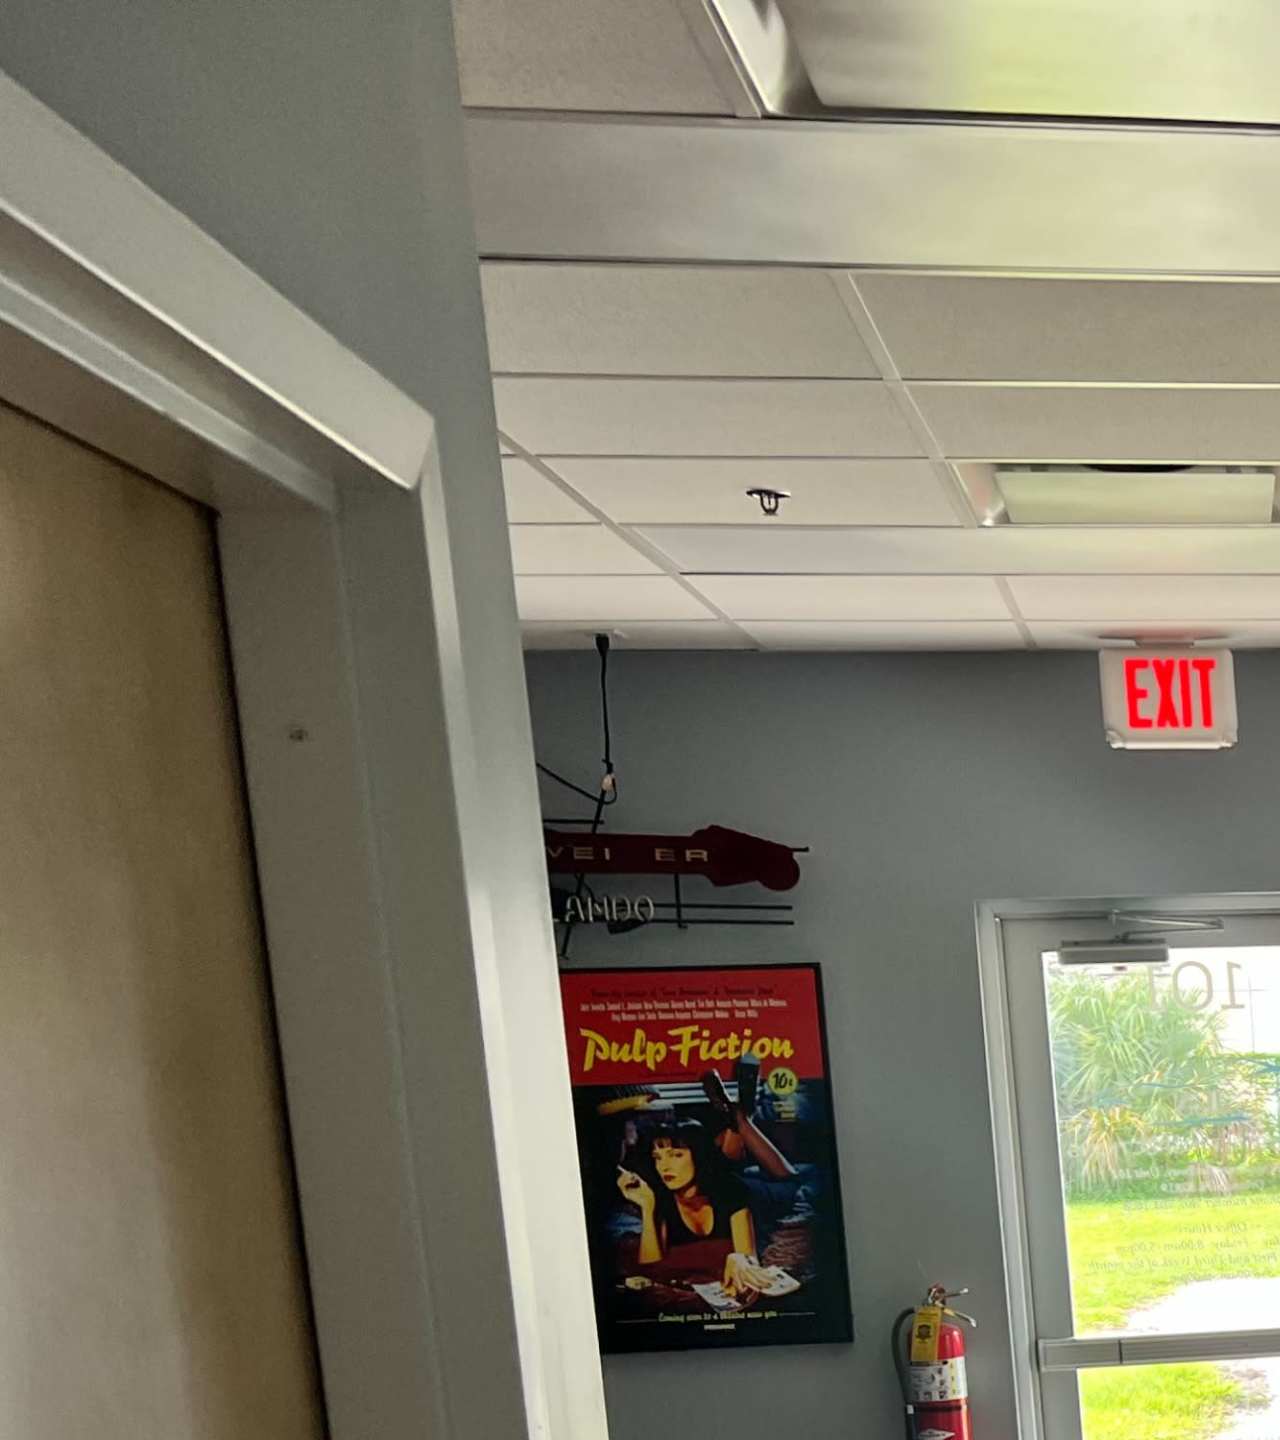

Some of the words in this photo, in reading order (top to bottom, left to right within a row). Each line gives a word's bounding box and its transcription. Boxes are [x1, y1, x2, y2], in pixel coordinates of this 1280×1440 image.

[1124, 658, 1216, 729] EXIT
[554, 894, 655, 923] ANDO
[579, 1027, 667, 1072] Pulp
[667, 1024, 795, 1067] Fiction
